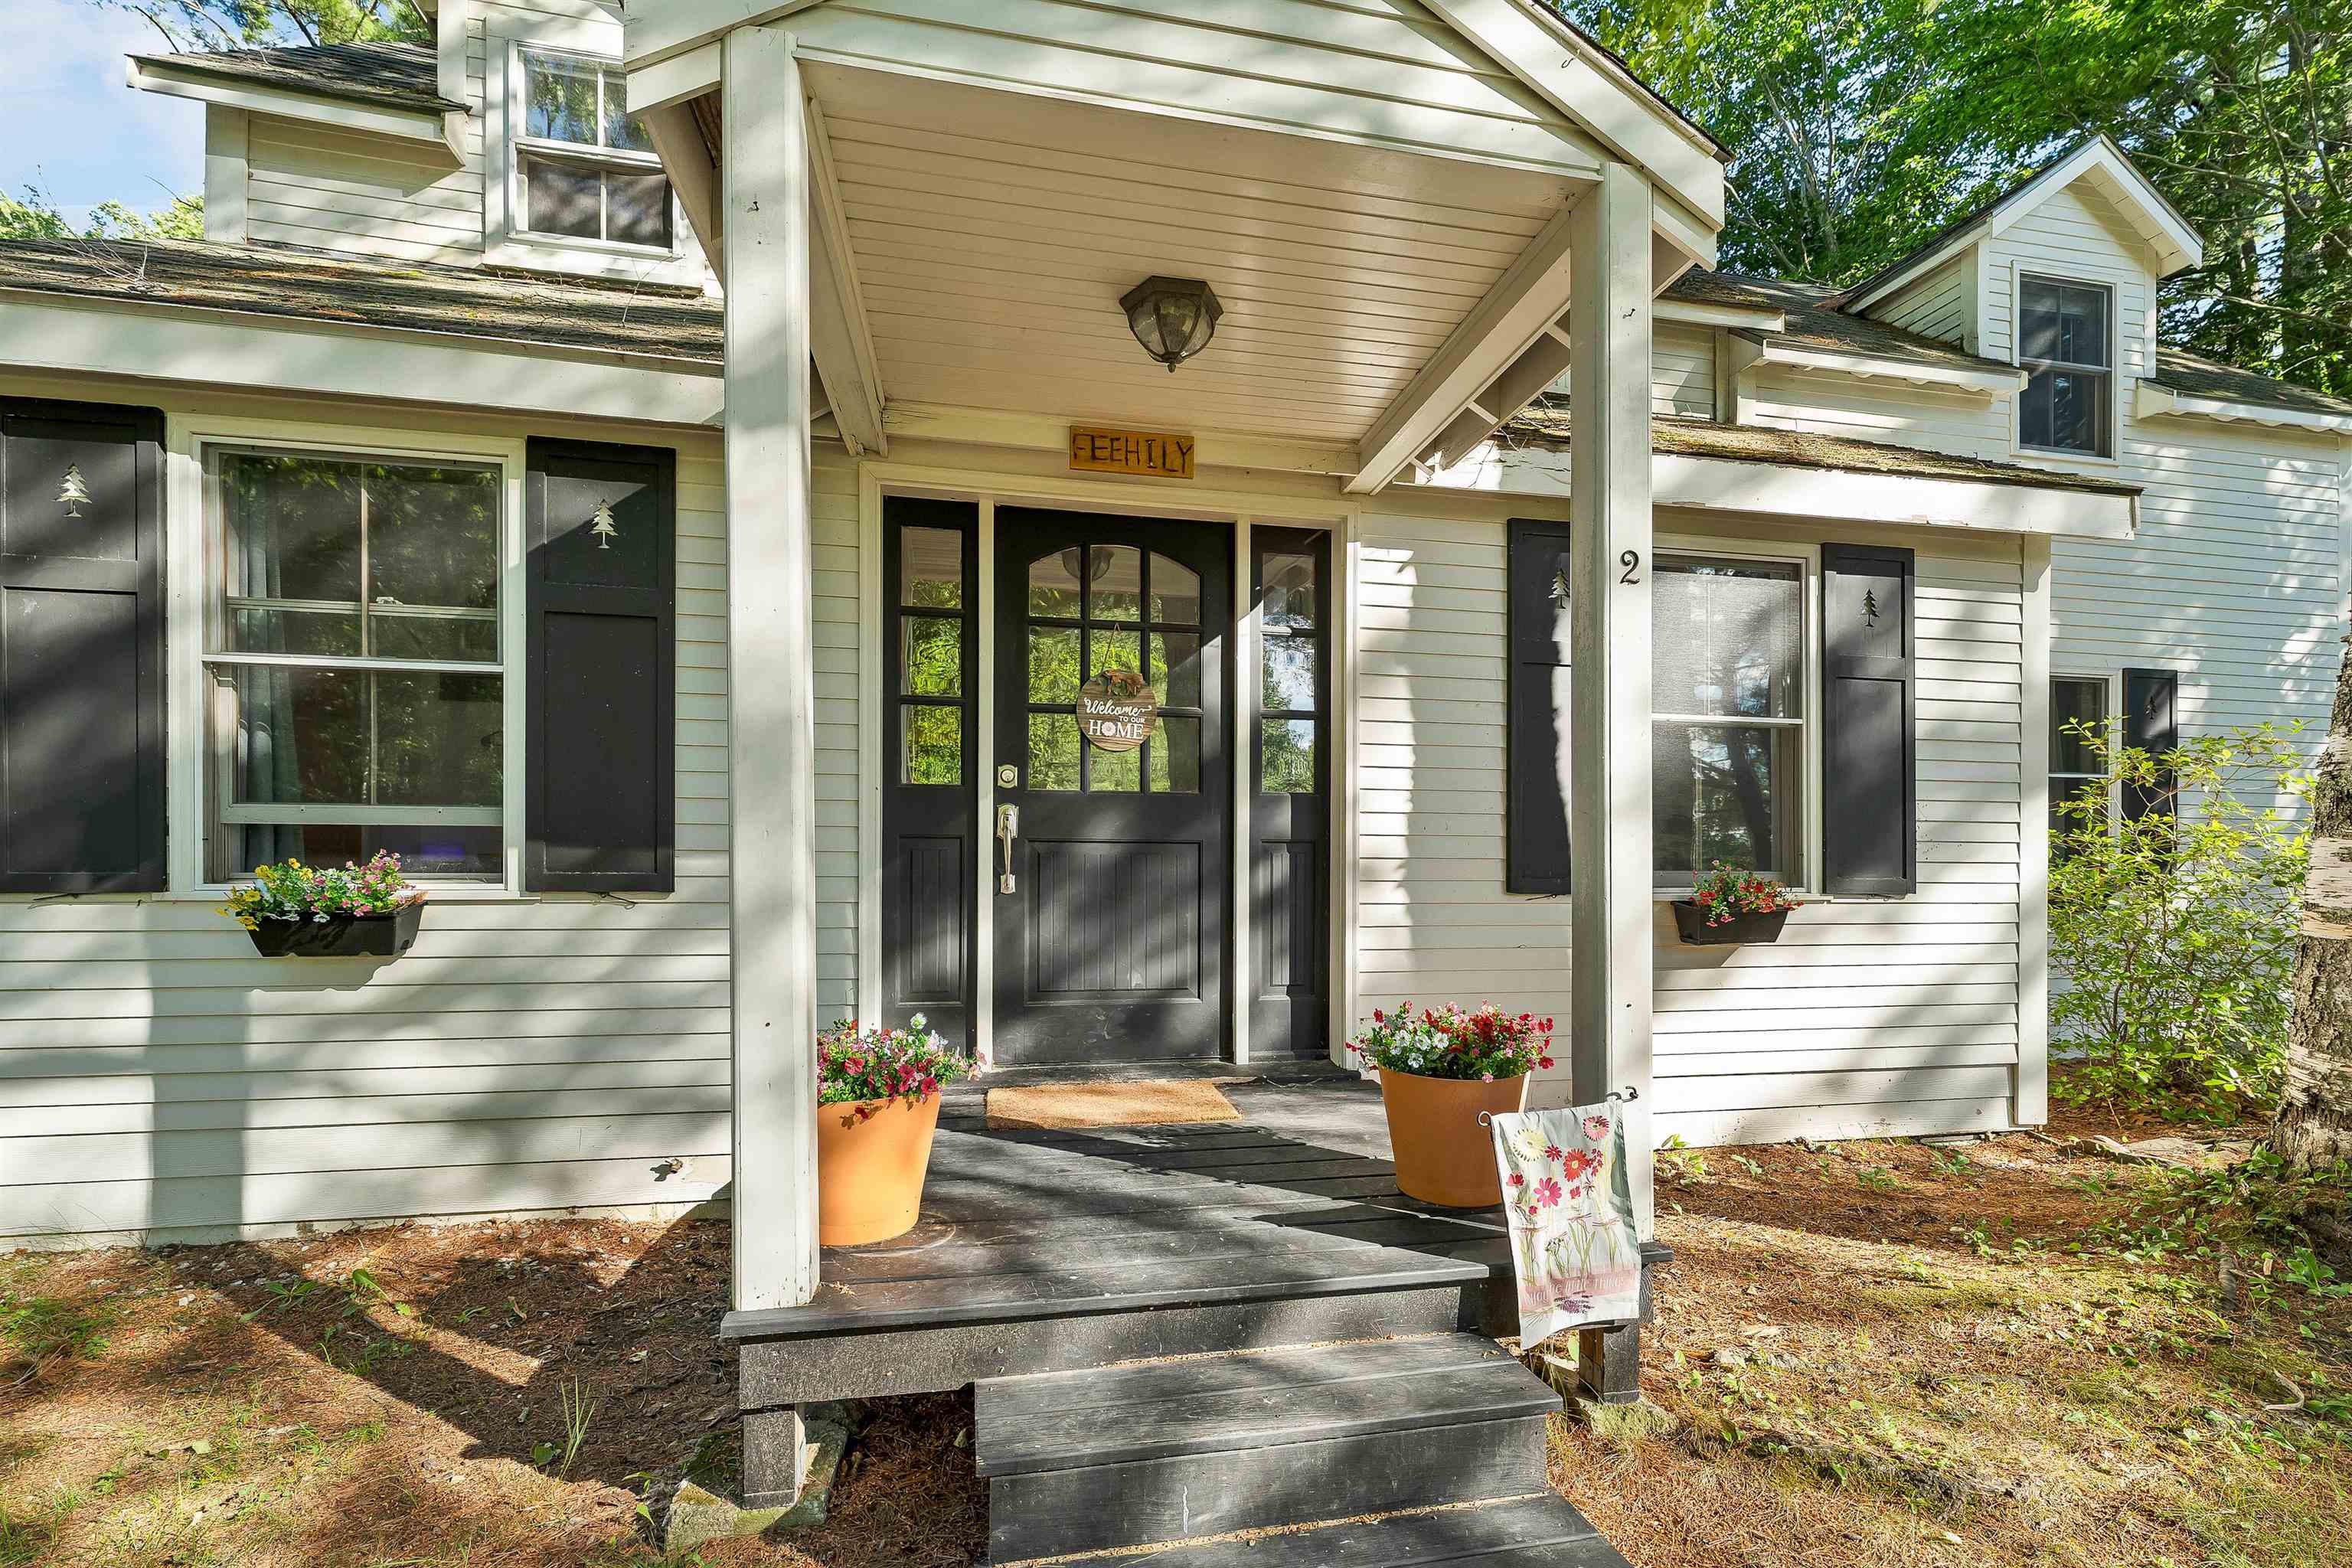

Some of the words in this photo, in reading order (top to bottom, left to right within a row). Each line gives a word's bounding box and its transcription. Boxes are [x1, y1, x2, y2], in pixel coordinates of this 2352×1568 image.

[1072, 433, 1194, 474] FEEHILY
[1619, 550, 1640, 585] 2
[1083, 697, 1152, 717] Welcome
[1088, 719, 1144, 740] HOME
